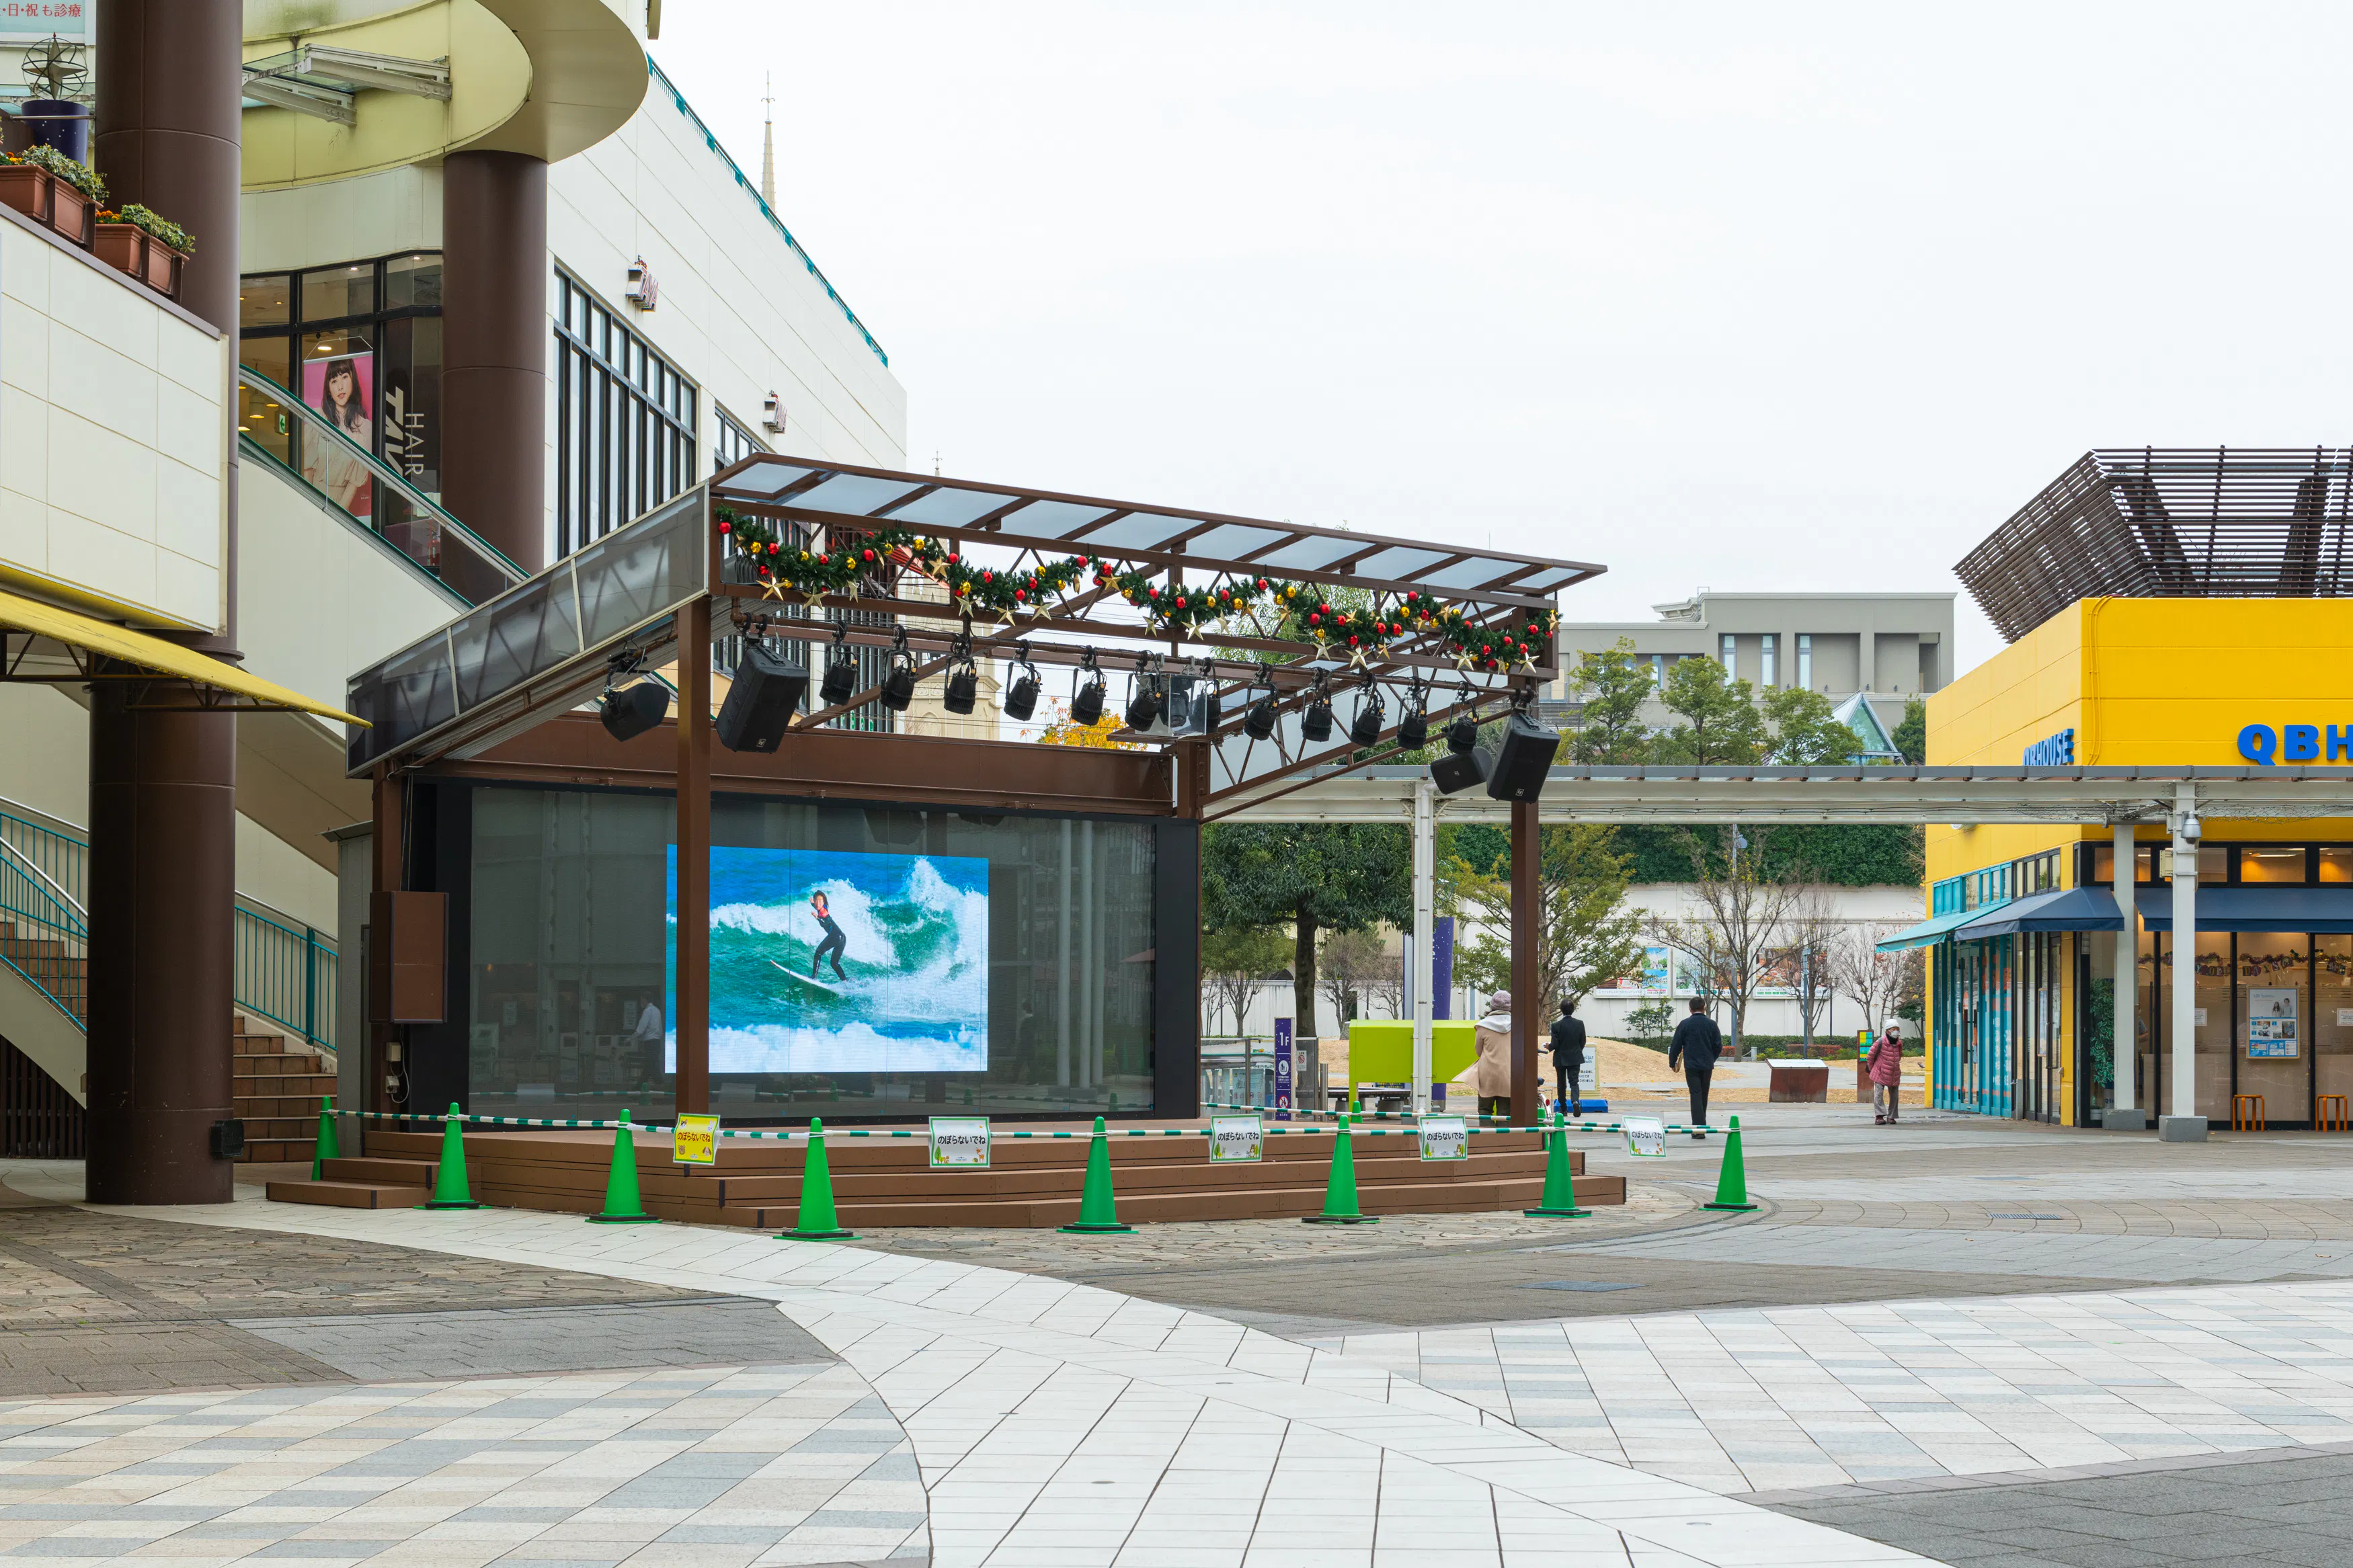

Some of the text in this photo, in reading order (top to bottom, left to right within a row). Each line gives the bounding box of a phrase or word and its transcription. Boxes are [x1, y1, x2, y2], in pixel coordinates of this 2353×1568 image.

[0, 3, 81, 17] ・日・祝も診療
[405, 413, 425, 476] HAIR
[1279, 1032, 1289, 1046] 1F
[677, 1132, 711, 1143] のぼらないでね
[937, 1134, 986, 1145] のぼらないでね
[1218, 1132, 1259, 1141] のぼらないでね
[1427, 1132, 1464, 1141] のぼらないでね
[1632, 1130, 1663, 1139] のぼらないでね
